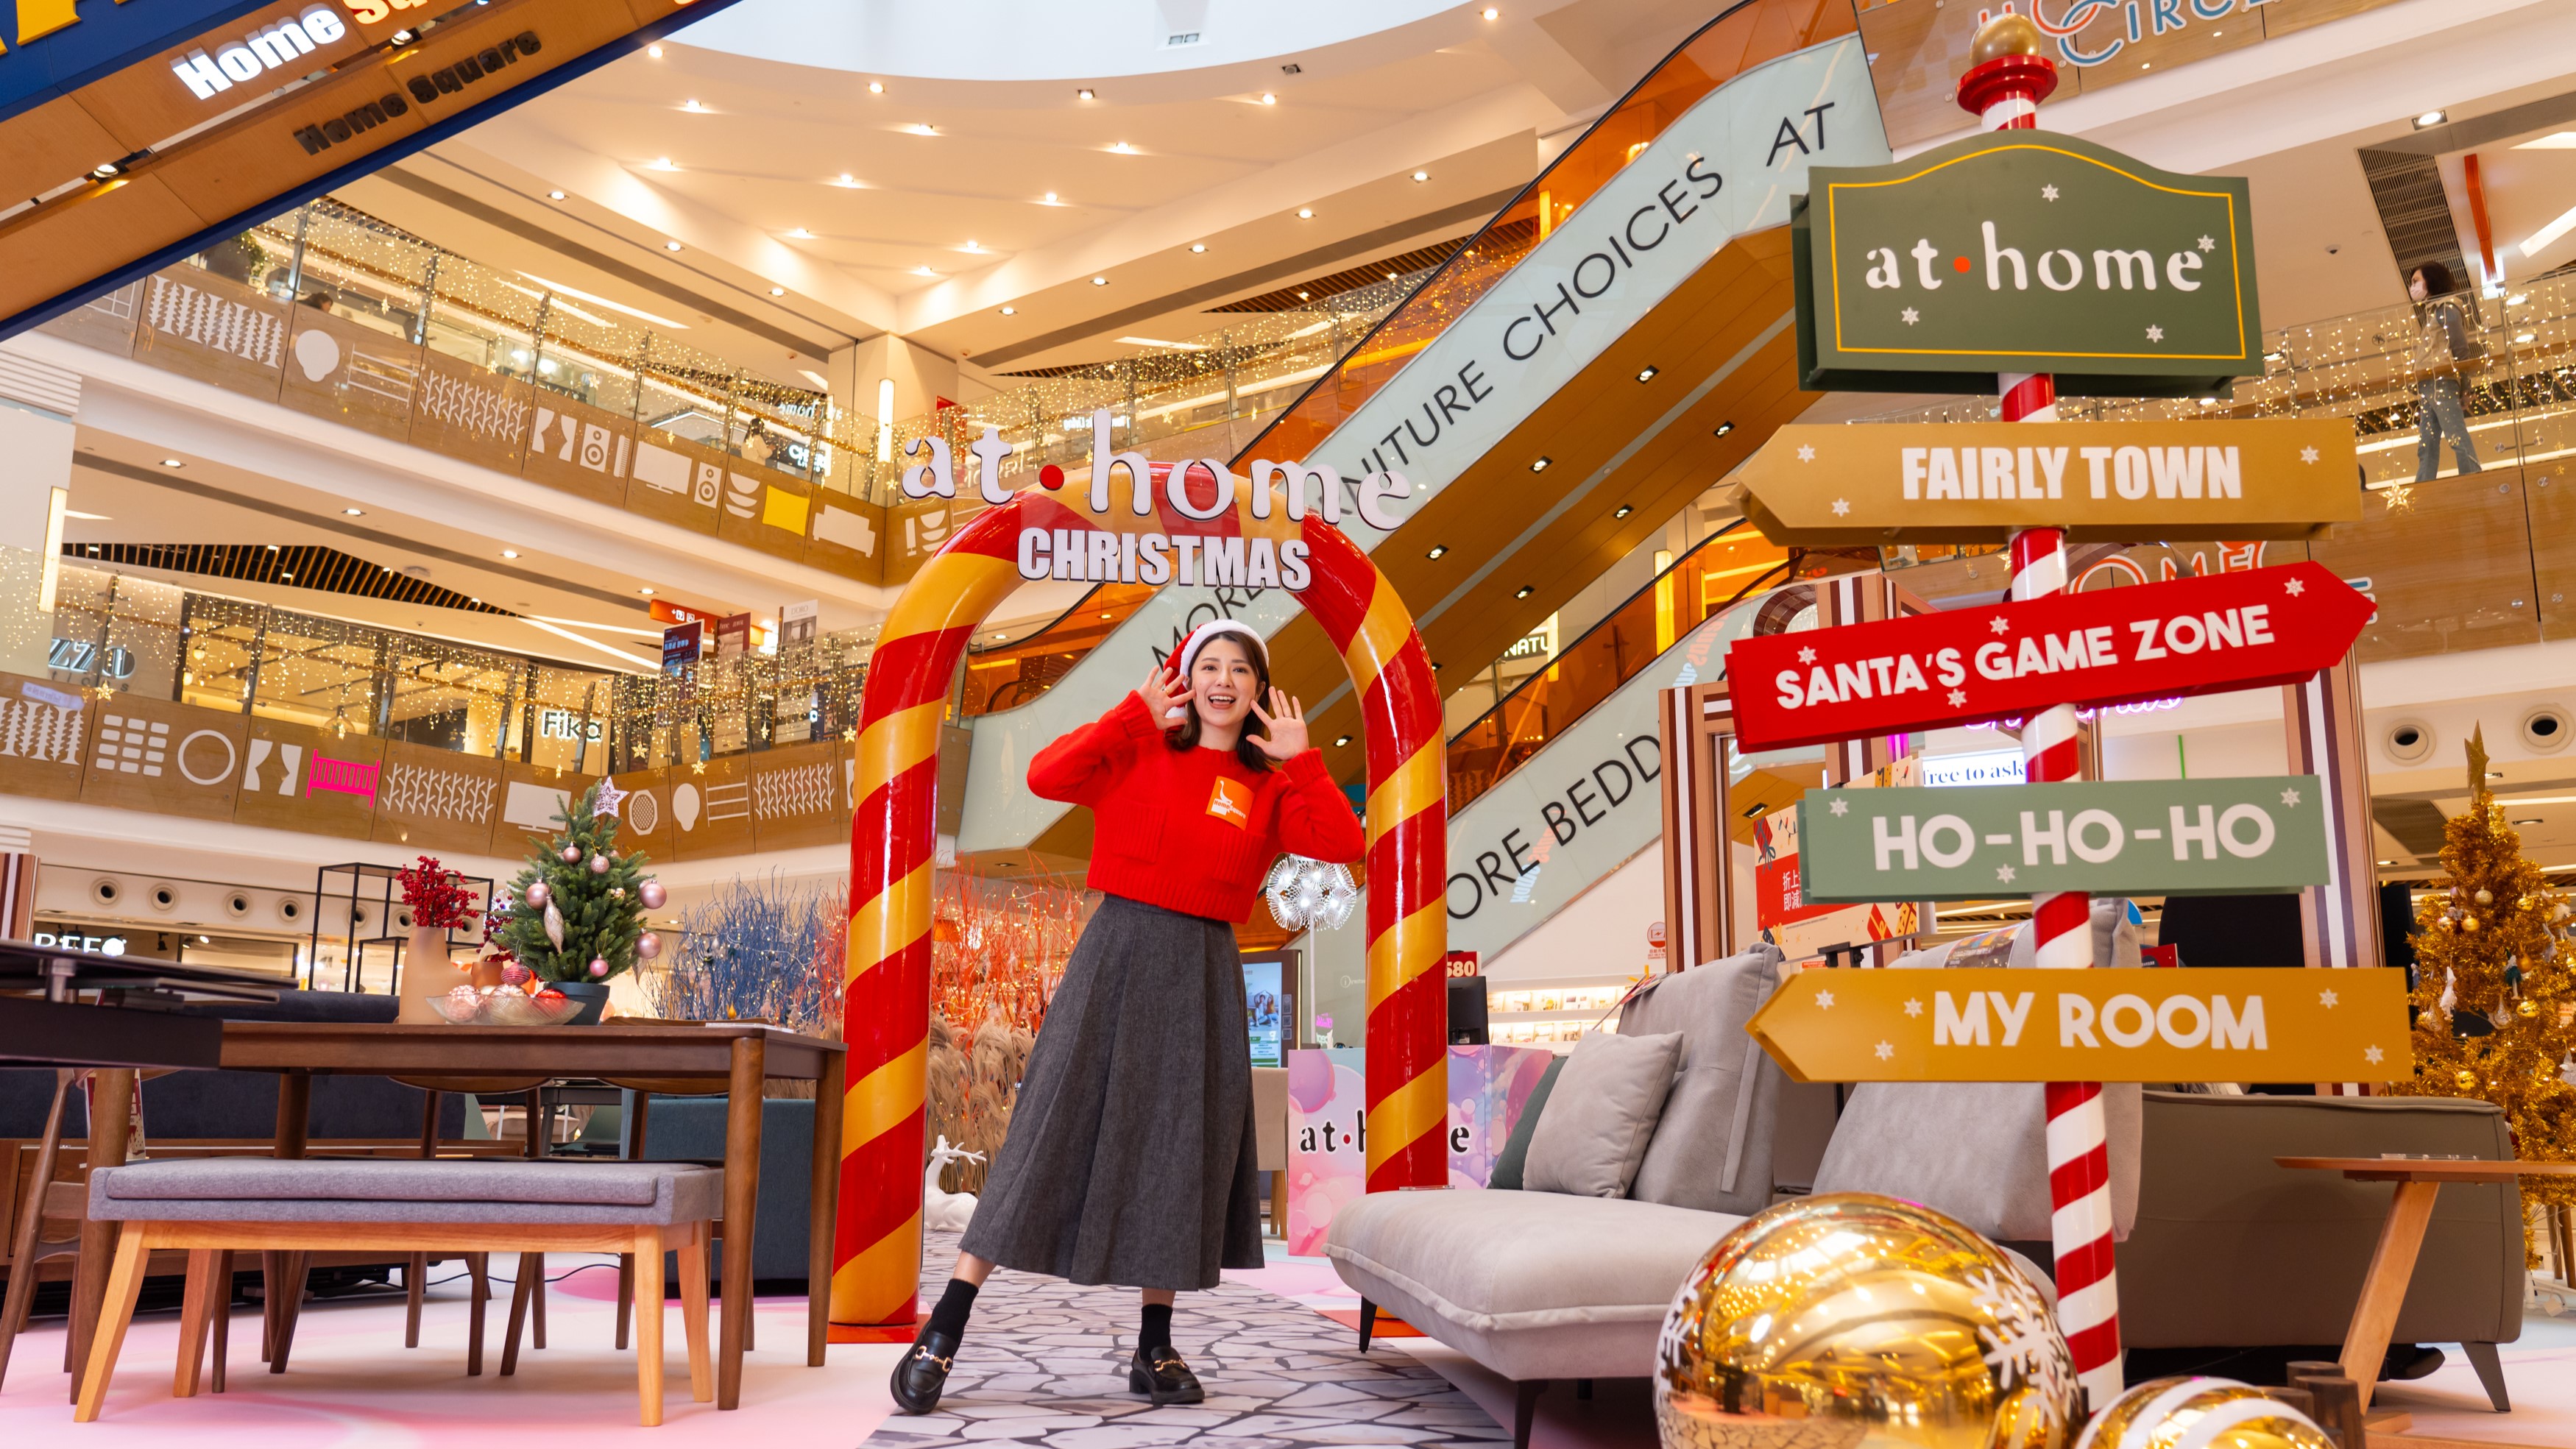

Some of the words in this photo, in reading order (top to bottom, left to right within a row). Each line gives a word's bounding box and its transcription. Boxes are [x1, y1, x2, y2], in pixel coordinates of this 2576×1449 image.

[171, 3, 346, 100] Home
[294, 93, 408, 155] Home
[1503, 156, 1723, 361] CHOICES
[1766, 101, 1836, 167] AT
[1903, 447, 2068, 499] FAIRLY
[2081, 447, 2241, 499] TOWN
[1017, 528, 1310, 592] CHRISTMAS
[1776, 648, 1965, 709] SANTA'S
[1975, 626, 2117, 681] GAME
[2131, 605, 2274, 660] ZONE
[543, 710, 603, 740] Fika
[1966, 767, 1985, 782] to
[1990, 759, 2025, 779] ask
[1873, 804, 2274, 871] HO-HO-HO
[1783, 869, 1801, 892] 折上
[1936, 992, 2034, 1045] MY
[2060, 994, 2265, 1048] ROOM
